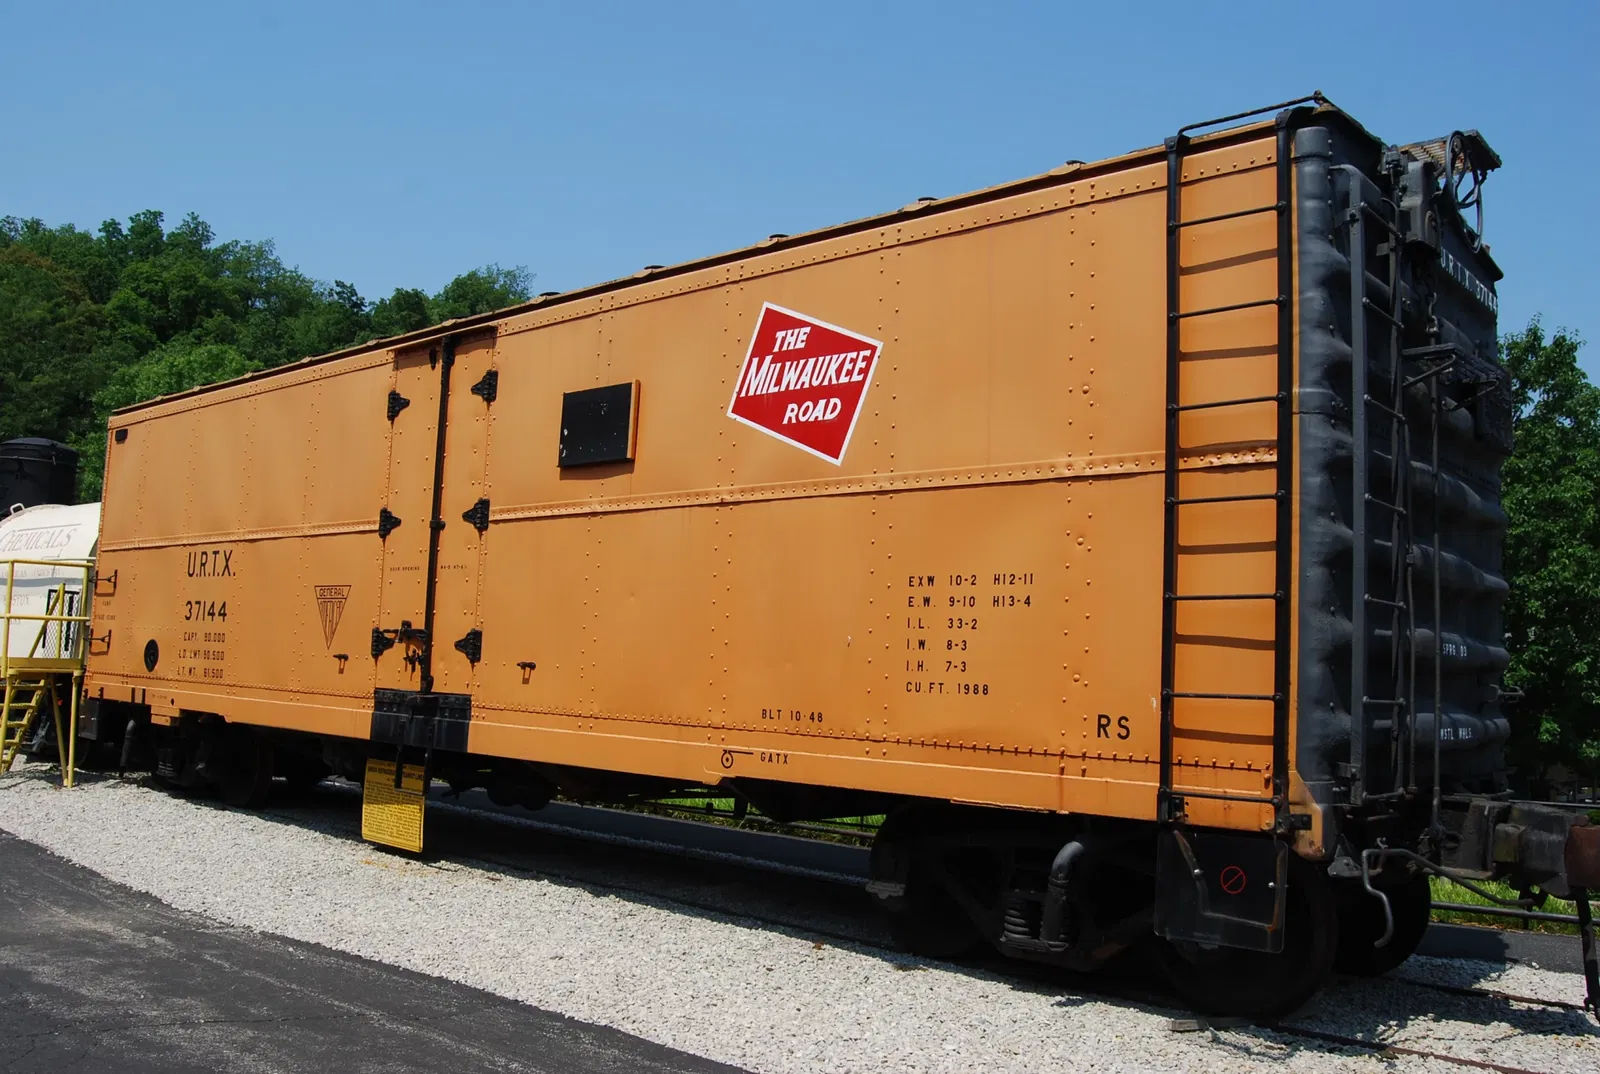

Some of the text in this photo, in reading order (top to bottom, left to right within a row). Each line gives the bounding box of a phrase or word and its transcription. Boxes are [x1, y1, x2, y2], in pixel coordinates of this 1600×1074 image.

[773, 326, 811, 352] THE
[739, 349, 871, 397] MILWAUKEE
[782, 397, 841, 424] ROAD
[187, 550, 236, 577] U.R.T.X.
[908, 573, 1034, 587] EXW 10-2 H12-11
[319, 587, 345, 597] GENERAL
[908, 595, 1031, 608] E.W. 9-10 H13-4
[184, 600, 228, 622] 37144
[907, 618, 978, 630] I.L. 33-2
[906, 639, 968, 651] I.W. 8-3
[906, 661, 967, 672] I.H. 7-3
[957, 683, 989, 696] 1988
[762, 709, 782, 720] BLT
[1097, 714, 1131, 740] RS
[760, 752, 788, 765] GATX
